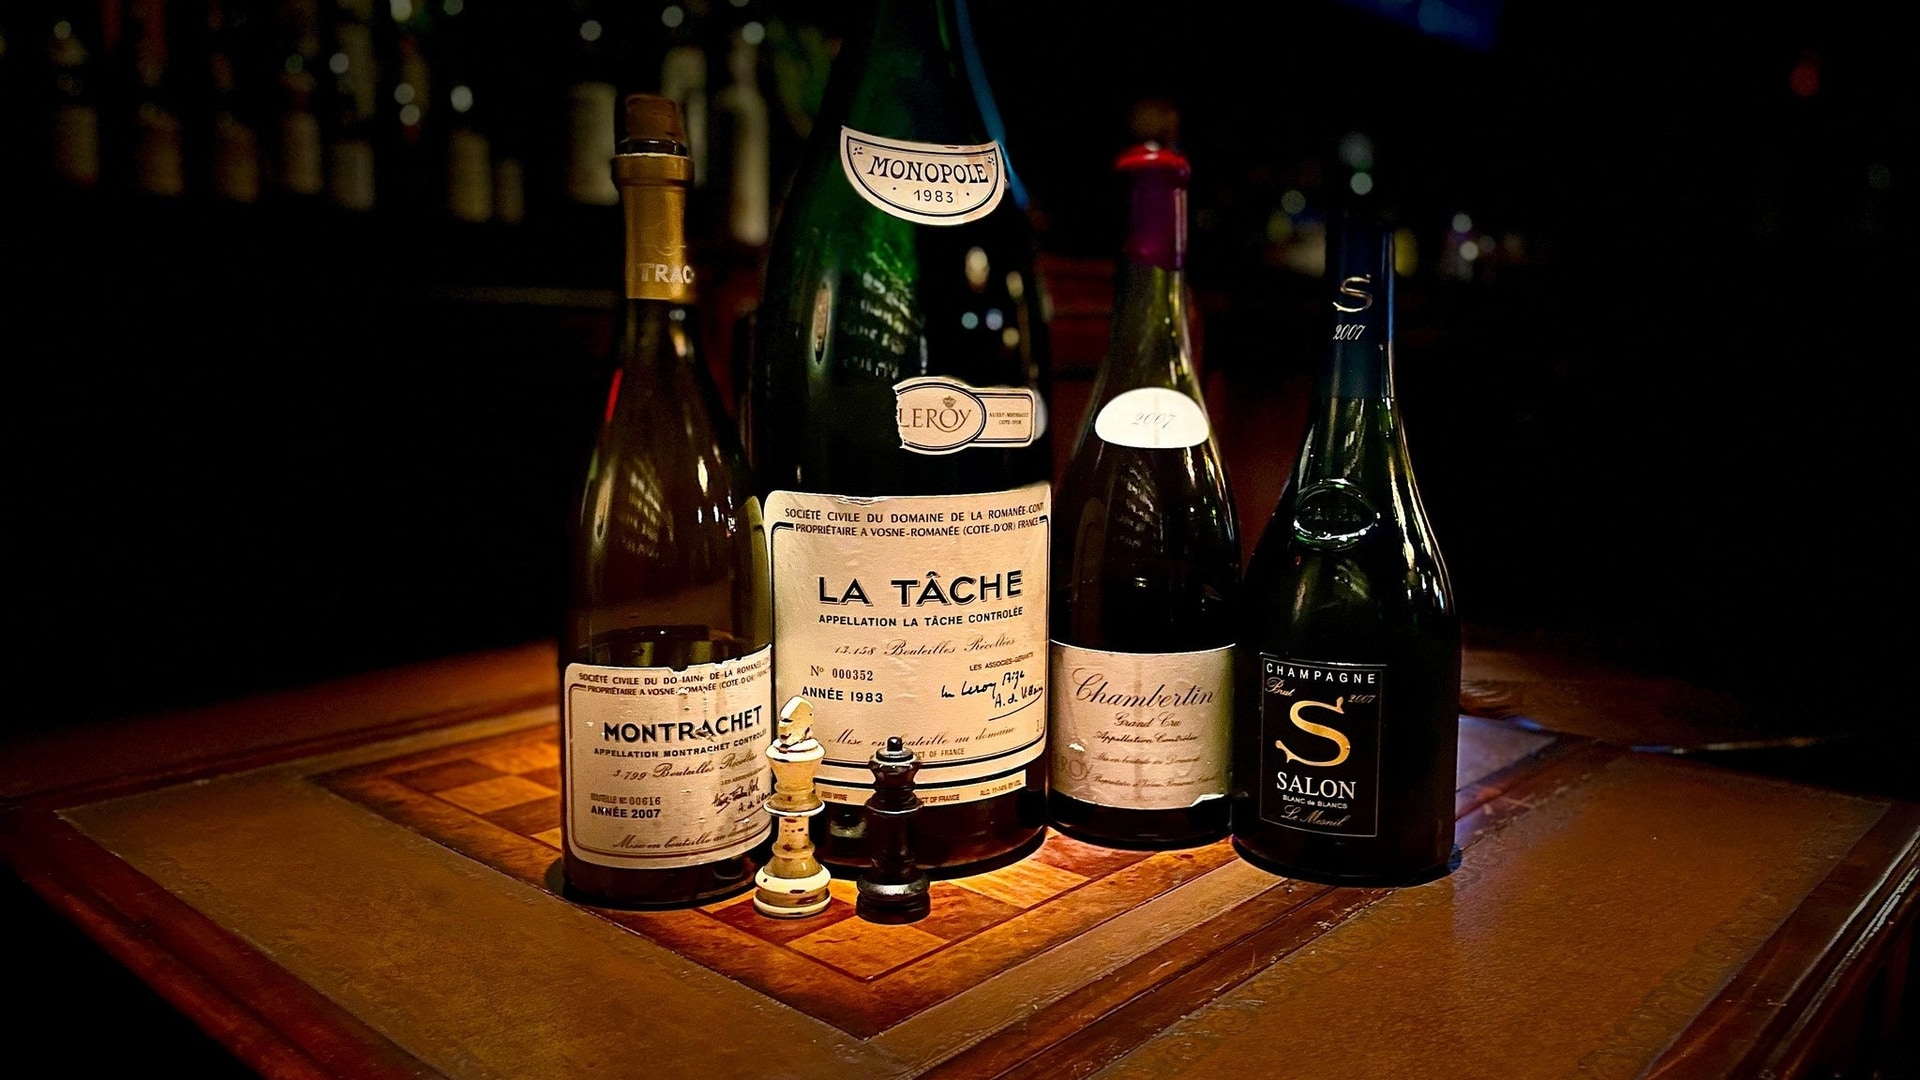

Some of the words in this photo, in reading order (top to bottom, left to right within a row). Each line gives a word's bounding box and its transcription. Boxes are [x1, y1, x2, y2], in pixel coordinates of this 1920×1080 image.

[867, 154, 989, 184] MONOPOLE
[913, 189, 954, 204] 1983
[1332, 273, 1373, 313] S
[1332, 324, 1366, 341] 2007
[898, 406, 972, 433] LEROY
[1131, 411, 1177, 429] 2007
[785, 507, 821, 521] SOCIÉTÉ
[827, 511, 860, 523] CIVILE
[867, 513, 883, 523] DU
[891, 512, 944, 523] DOMAINE
[951, 511, 965, 522] DE
[971, 511, 983, 521] LA
[988, 502, 1044, 519] ROMANÉE-CONT
[795, 523, 857, 536] PROPRIÉTAIRE
[860, 527, 868, 537] A
[870, 525, 960, 537] VOSNE-ROMANÉE
[1018, 517, 1038, 529] FRANCE
[818, 576, 873, 607] LA
[890, 569, 1023, 607] TÂCHE
[818, 614, 897, 627] APPELLATION
[903, 617, 919, 627] LA
[924, 614, 963, 627] TÂCHE
[968, 605, 1024, 624] CONTROLÉE
[884, 638, 956, 656] Bouteilles
[579, 672, 608, 684] SOCIÉTÉ
[612, 676, 640, 685] CIVILE
[644, 677, 658, 685] DU
[709, 671, 720, 681] DE
[724, 669, 733, 678] LA
[832, 668, 874, 681] 000352
[1266, 662, 1376, 684] CHAMPAGNE
[801, 685, 844, 701] ANNÉE
[851, 691, 884, 703] 1983
[1071, 667, 1214, 708] Chambertin
[1265, 676, 1296, 697] Brut
[1348, 694, 1376, 704] 2007
[603, 704, 762, 744] MONTRACHET
[1114, 711, 1154, 728] Grand
[1158, 711, 1182, 728] Cru
[828, 728, 862, 745] Mise
[1093, 731, 1153, 744] Appellation
[1275, 696, 1351, 767] S
[593, 747, 659, 758] APPELLATION
[664, 742, 730, 758] MONTRACHET
[929, 749, 937, 758] OF
[941, 747, 965, 756] FRANCE
[1276, 771, 1357, 800] SALON
[629, 796, 661, 806] 00616
[833, 793, 848, 801] WINE
[938, 793, 960, 802] FRANCE
[1282, 794, 1306, 805] BLANC
[1317, 801, 1348, 809] BLANCS
[591, 805, 628, 818] ANNÉE
[631, 808, 661, 818] 2007
[1300, 810, 1350, 827] Mesnil
